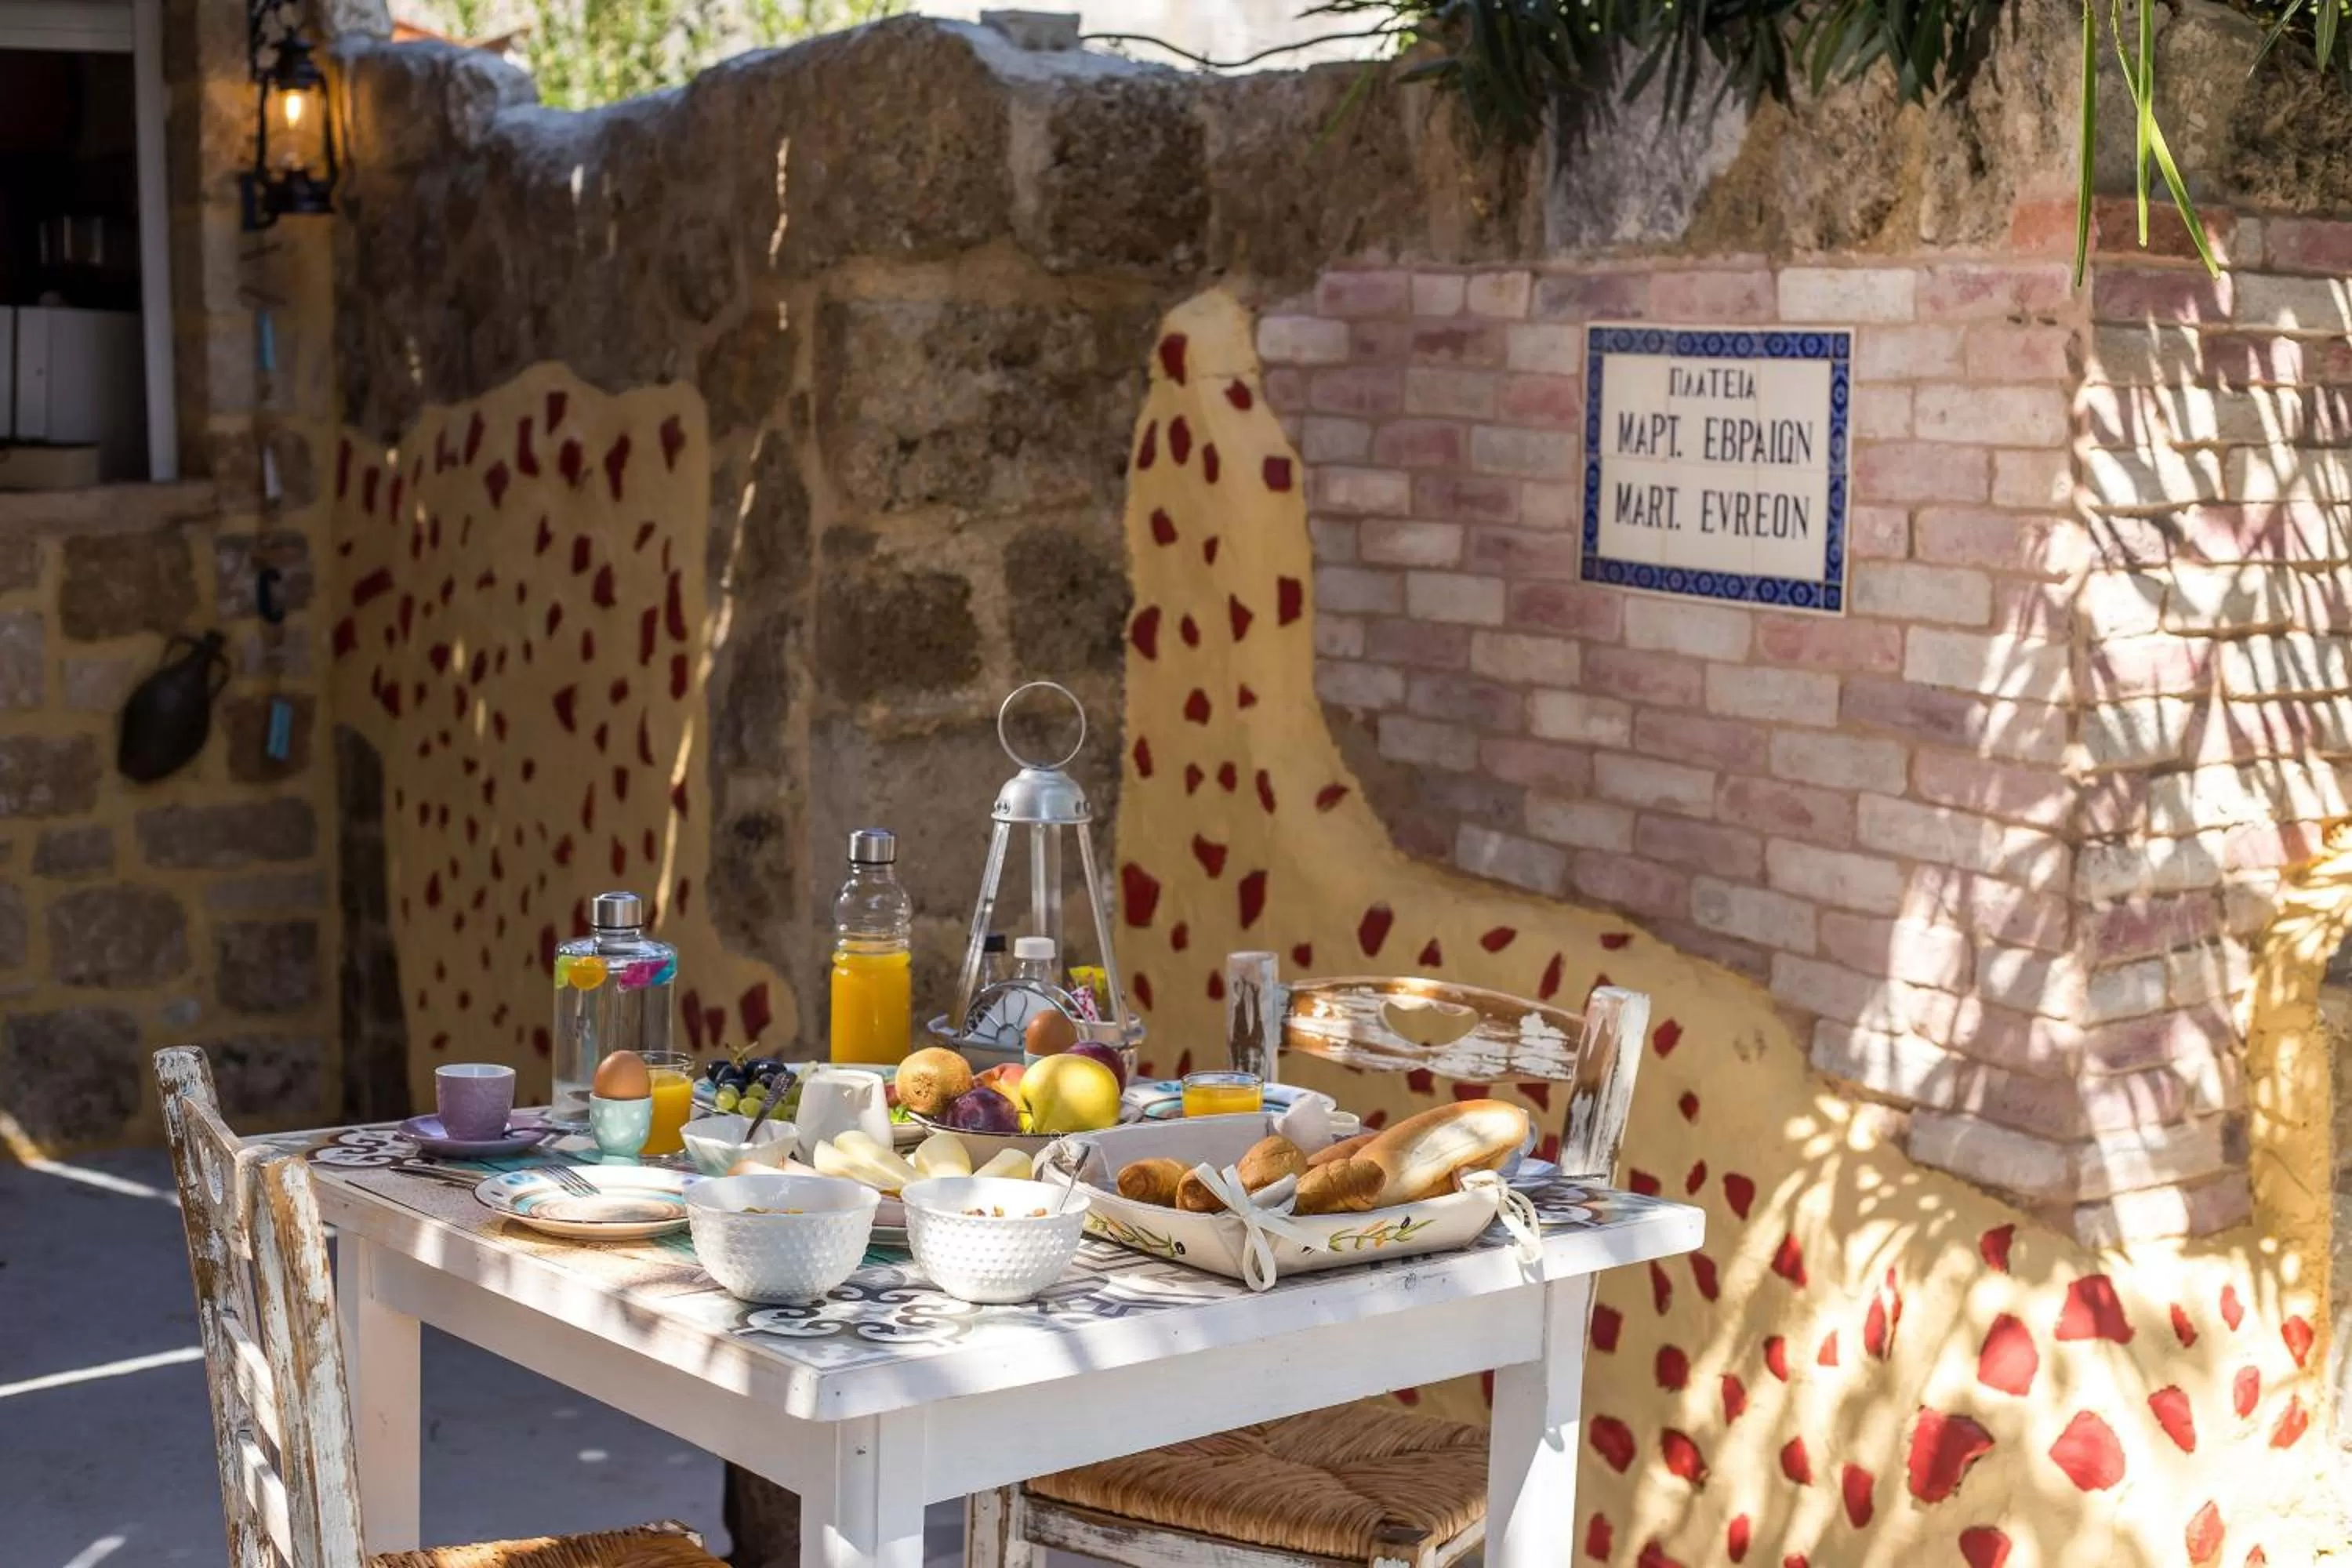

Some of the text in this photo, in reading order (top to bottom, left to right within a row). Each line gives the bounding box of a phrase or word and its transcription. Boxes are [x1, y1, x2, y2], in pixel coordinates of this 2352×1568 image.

[1617, 411, 1813, 463] ΜΑΡΤ. ΕΒΡΑΙΩΝ
[1614, 481, 1809, 539] MART. EVREON
